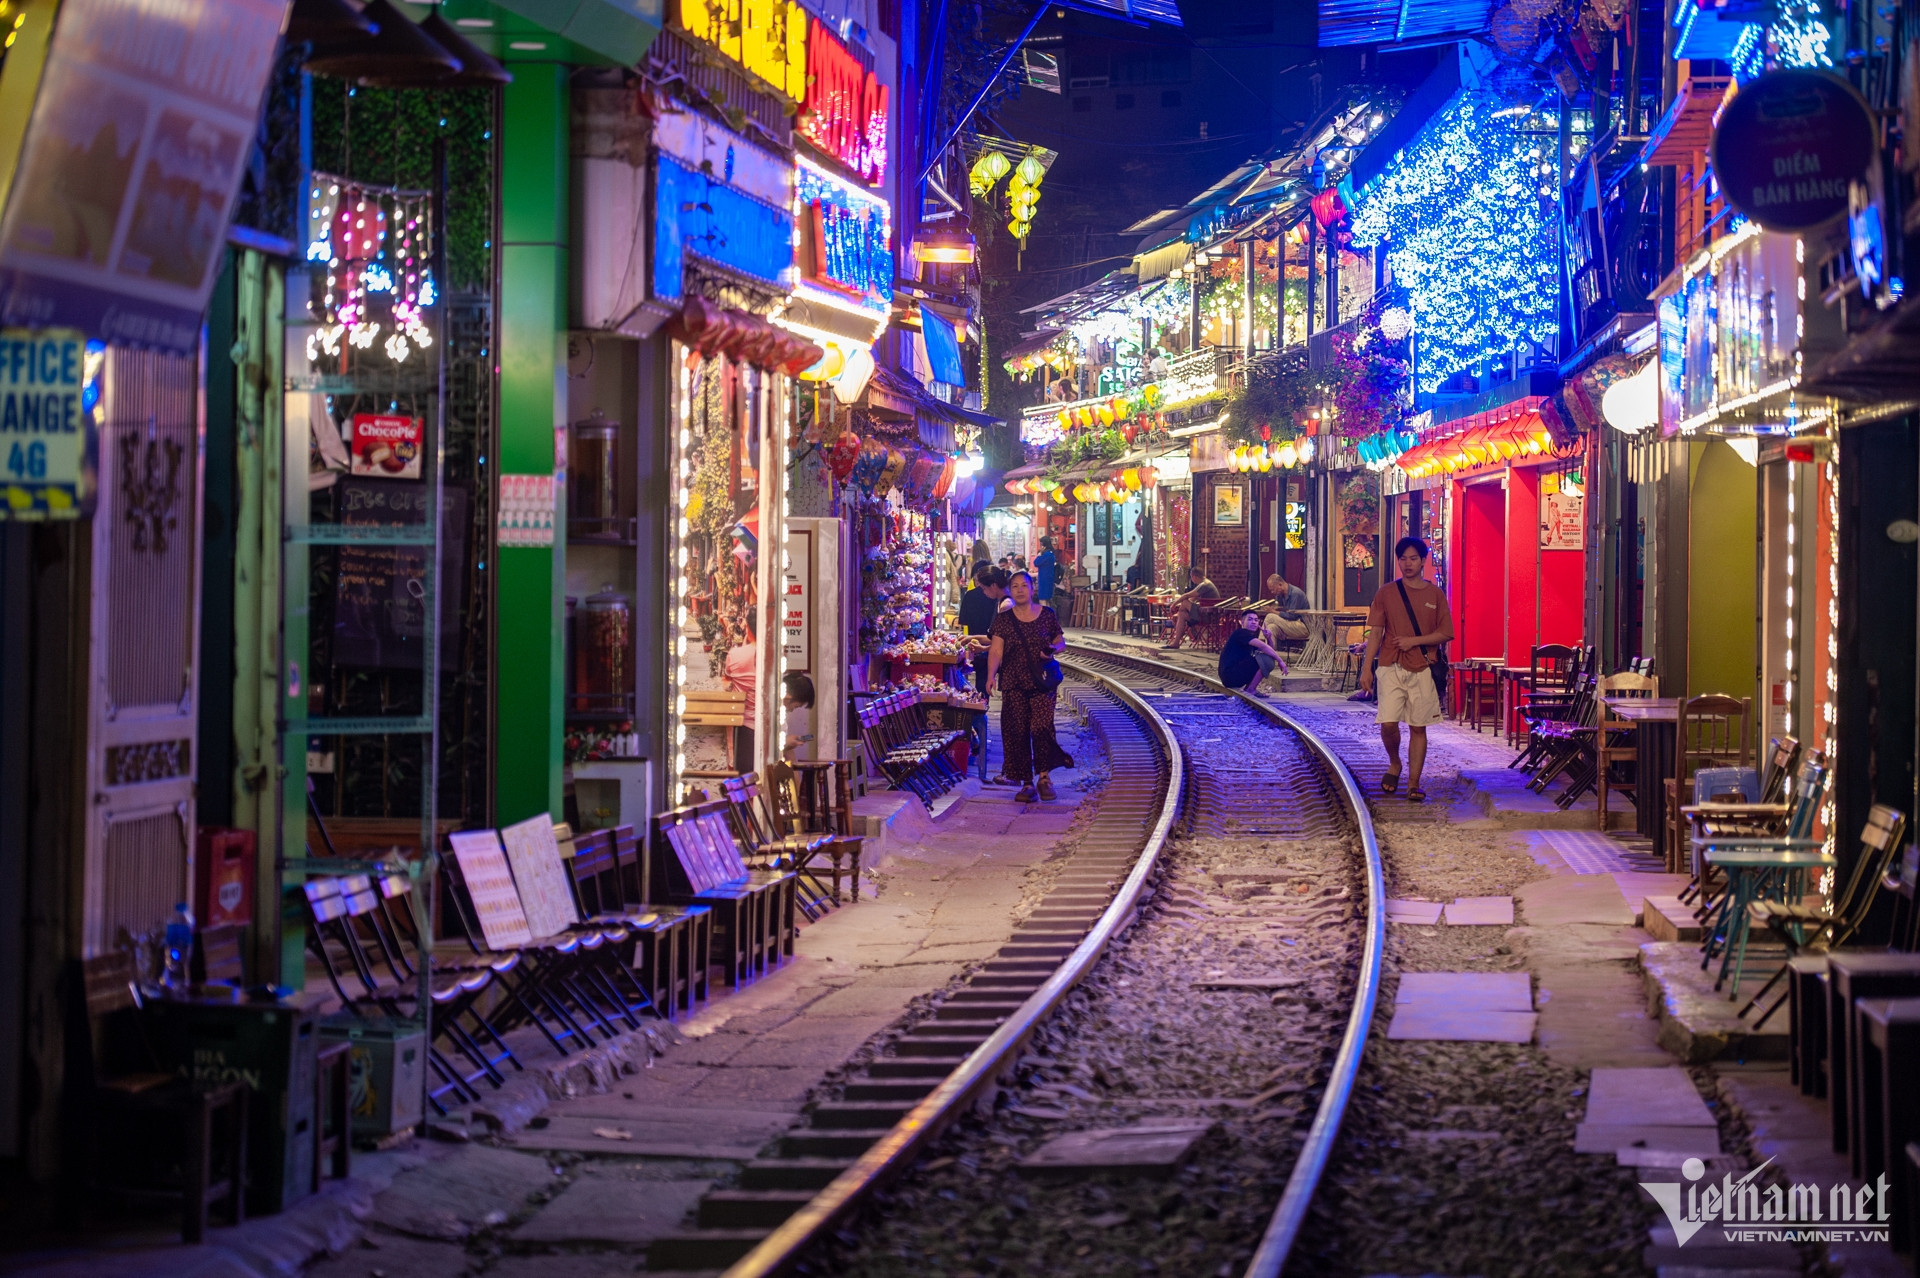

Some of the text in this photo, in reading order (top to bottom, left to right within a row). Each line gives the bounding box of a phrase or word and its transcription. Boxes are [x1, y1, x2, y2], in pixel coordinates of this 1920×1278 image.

[0, 340, 78, 386] FFICE
[0, 392, 76, 434] ANGE
[358, 422, 416, 439] ChocoPie
[8, 440, 47, 478] 4G
[1158, 532, 1166, 540] 74
